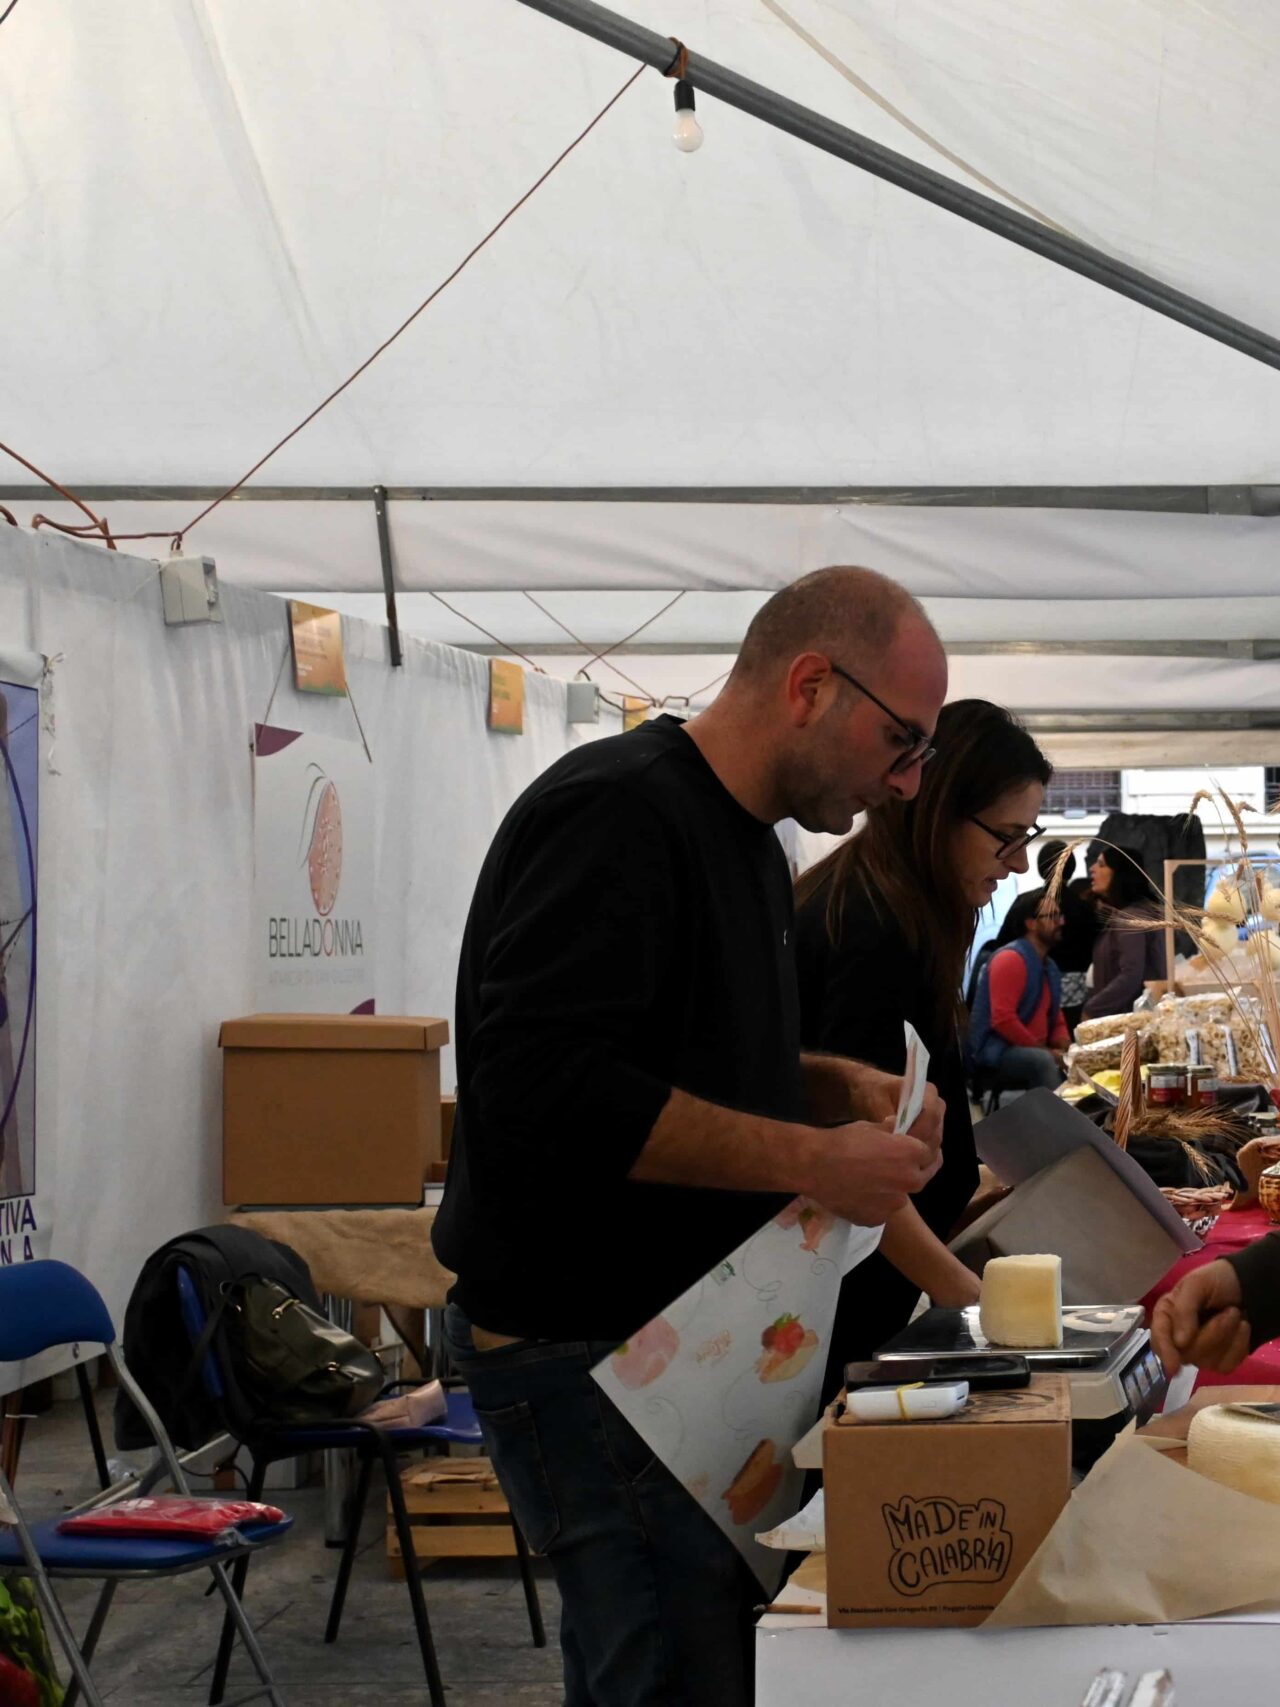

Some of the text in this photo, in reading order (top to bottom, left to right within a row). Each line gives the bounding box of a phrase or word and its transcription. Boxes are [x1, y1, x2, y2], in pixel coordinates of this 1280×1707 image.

[269, 917, 364, 957] BELLADONNA
[888, 1501, 997, 1543] MADE IN
[897, 1531, 1006, 1588] CALABRIA
